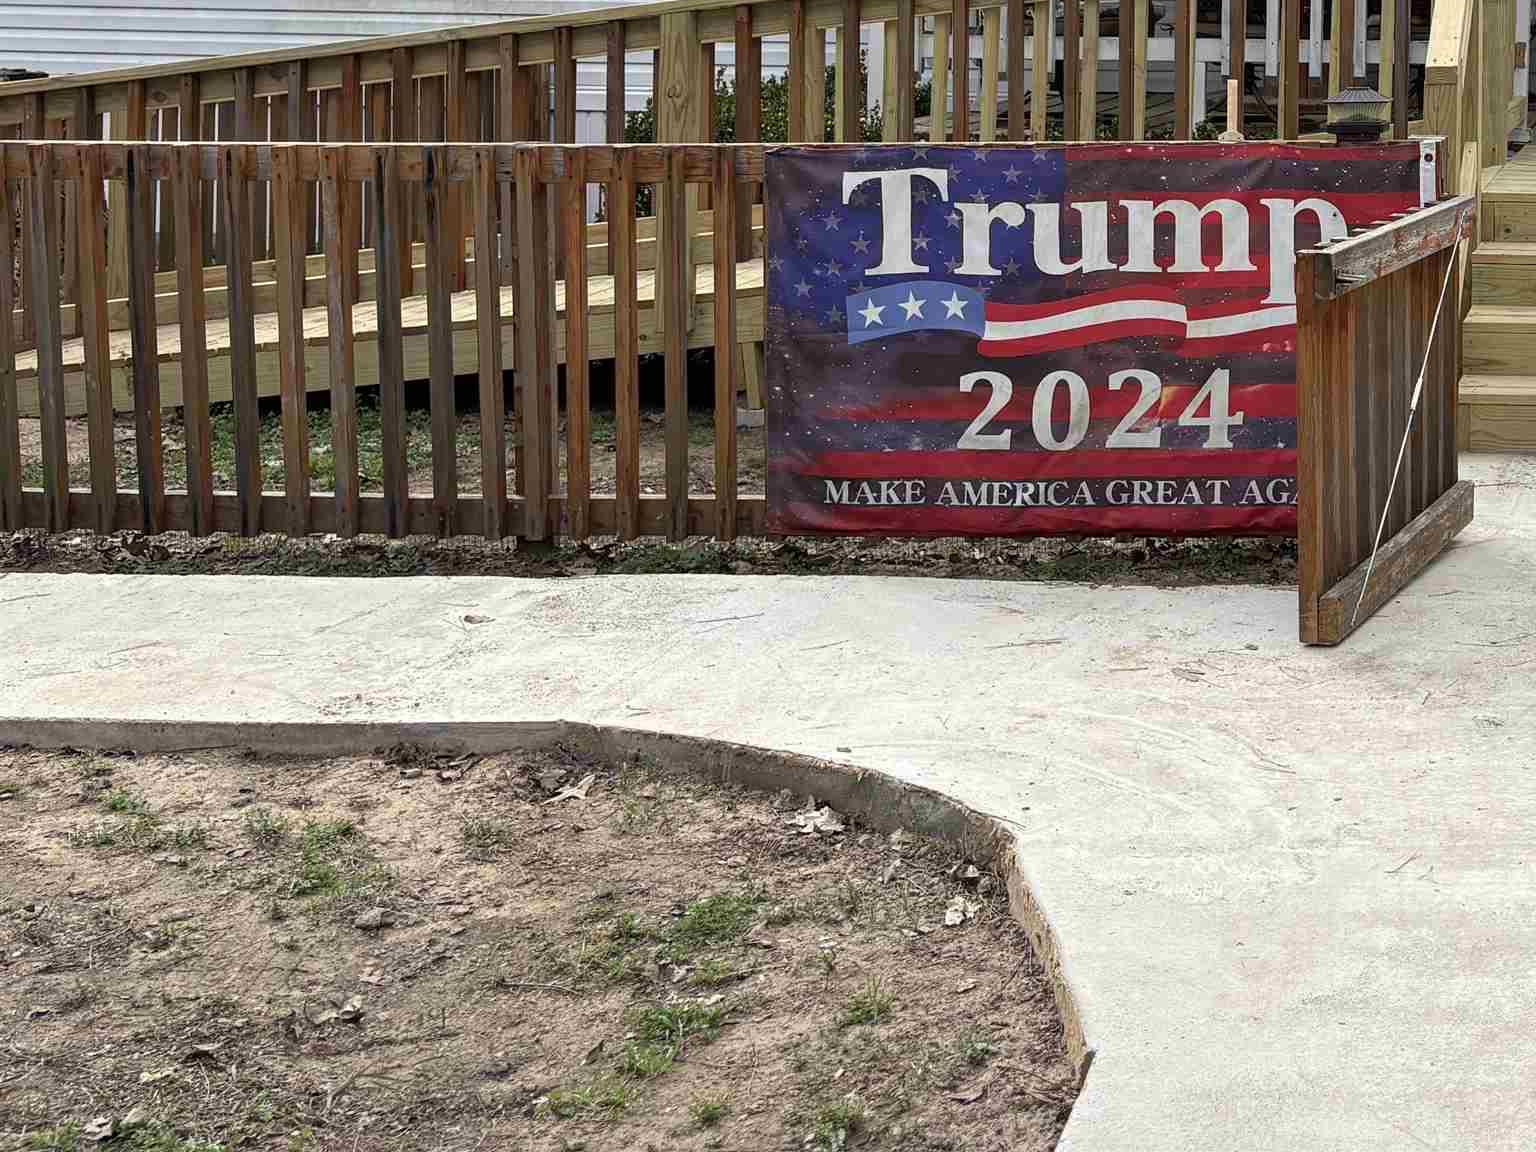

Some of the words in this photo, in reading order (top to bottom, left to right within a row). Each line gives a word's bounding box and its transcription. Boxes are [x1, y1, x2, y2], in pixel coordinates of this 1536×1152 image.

[842, 167, 1350, 305] Trump
[957, 367, 1245, 451] 2024
[824, 479, 926, 506] MAKE
[934, 480, 1096, 507] AMERICA
[1105, 480, 1231, 506] GREAT
